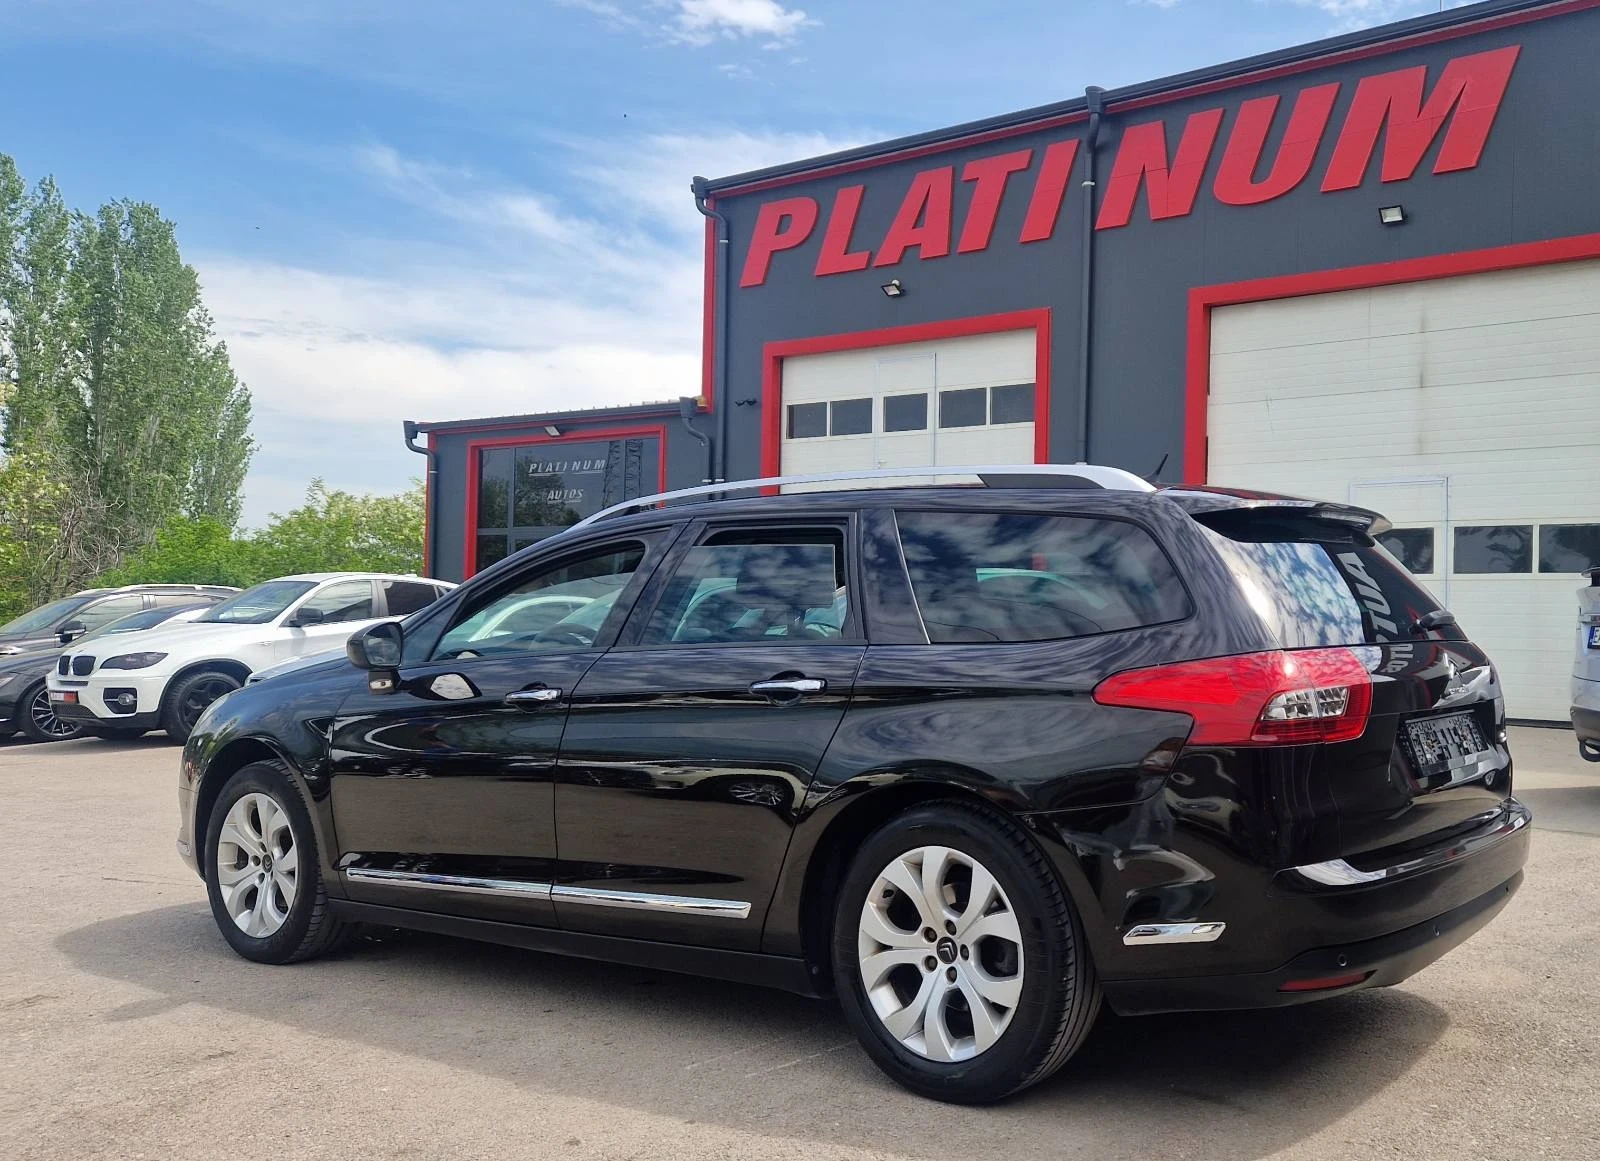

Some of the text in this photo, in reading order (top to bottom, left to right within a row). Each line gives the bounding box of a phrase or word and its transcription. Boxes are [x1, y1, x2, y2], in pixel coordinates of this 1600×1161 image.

[740, 45, 1521, 287] PLATINUM
[529, 459, 606, 473] PLATINUM
[547, 489, 584, 501] AUTOS
